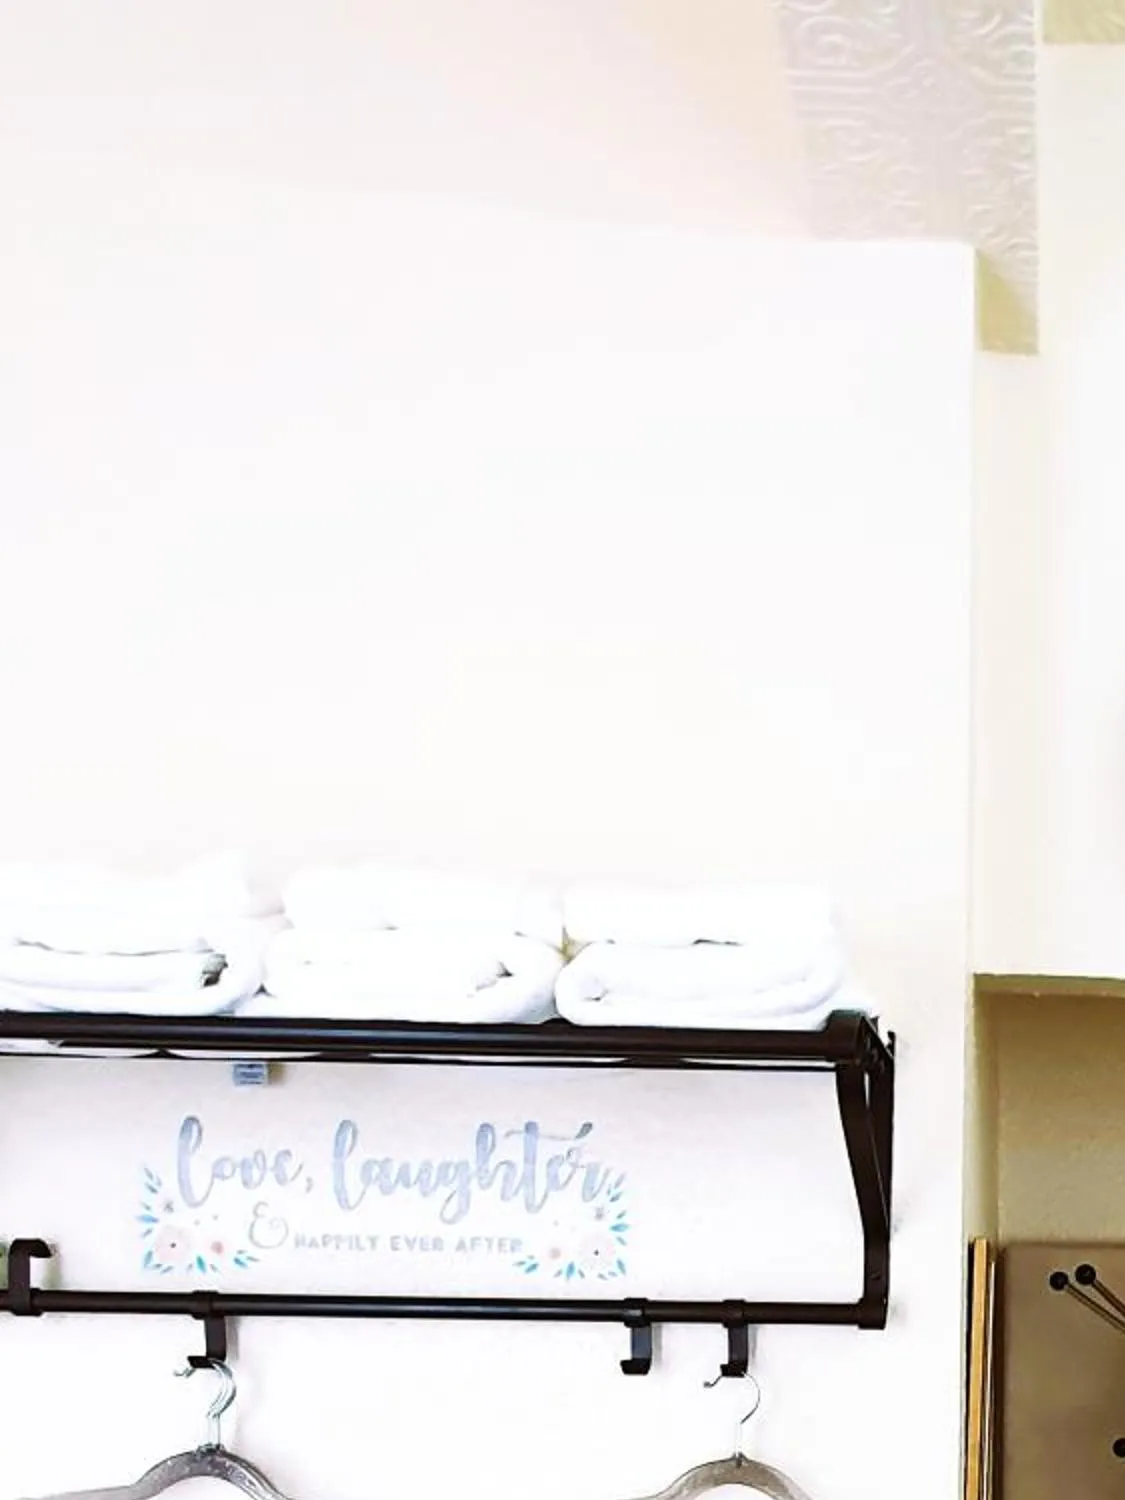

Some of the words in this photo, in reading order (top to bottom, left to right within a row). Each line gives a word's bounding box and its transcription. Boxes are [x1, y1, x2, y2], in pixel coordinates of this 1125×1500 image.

[176, 1114, 314, 1209] love,
[330, 1119, 613, 1226] laughter
[293, 1233, 380, 1251] HAPPILY
[389, 1235, 445, 1252] EVER
[455, 1235, 524, 1254] AFTER
